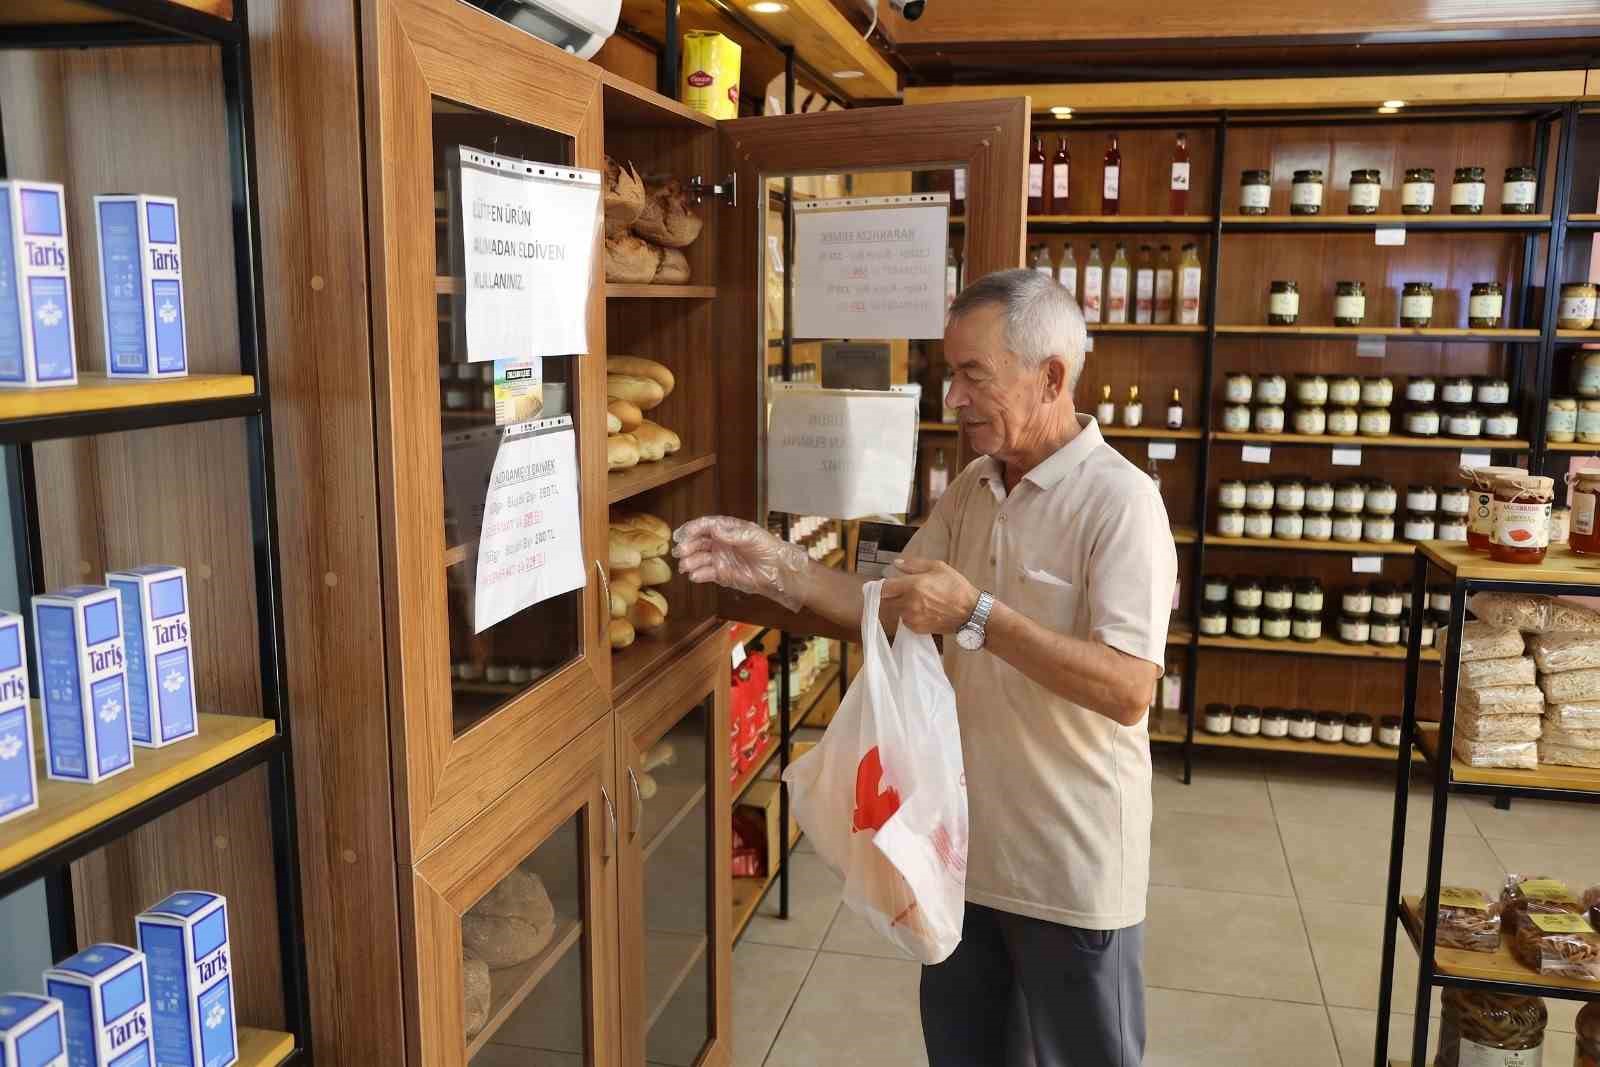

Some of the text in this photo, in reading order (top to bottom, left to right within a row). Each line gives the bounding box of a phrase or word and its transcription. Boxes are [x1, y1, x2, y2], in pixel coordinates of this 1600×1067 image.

[473, 198, 531, 226] LÜTFEN ÜRÜN
[24, 241, 66, 270] Tariş
[150, 248, 180, 274] Tariş
[518, 240, 566, 260] ELDİVEN
[153, 618, 188, 643] Tariş
[88, 643, 123, 673] Tariş
[196, 950, 228, 985] Tariş
[105, 1011, 147, 1050] Tariş
